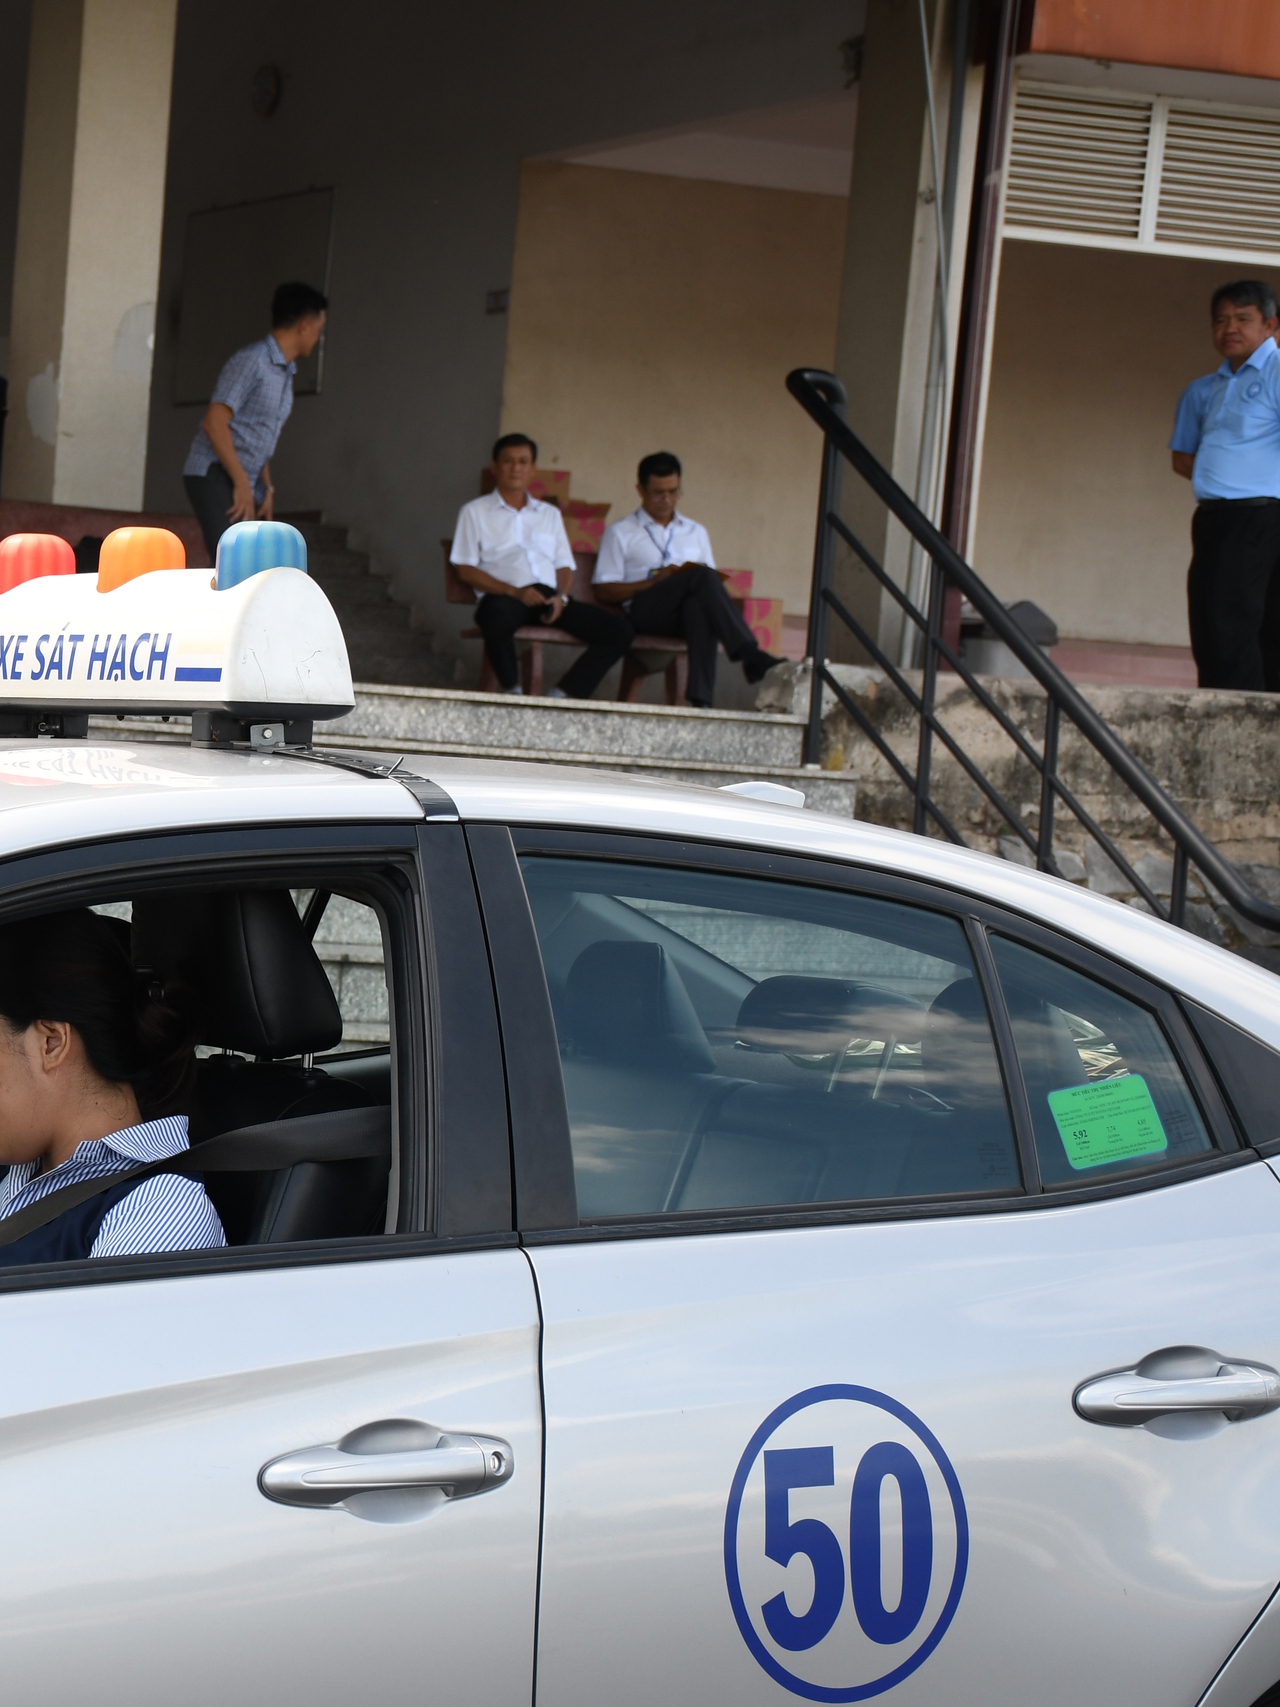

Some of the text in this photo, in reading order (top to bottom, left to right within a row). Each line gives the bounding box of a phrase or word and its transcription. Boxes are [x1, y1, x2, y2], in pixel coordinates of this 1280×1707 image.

[30, 622, 84, 681] SÁT
[86, 633, 172, 683] HẠCH
[1073, 1129, 1088, 1140] 5,92
[761, 1441, 933, 1652] 50
